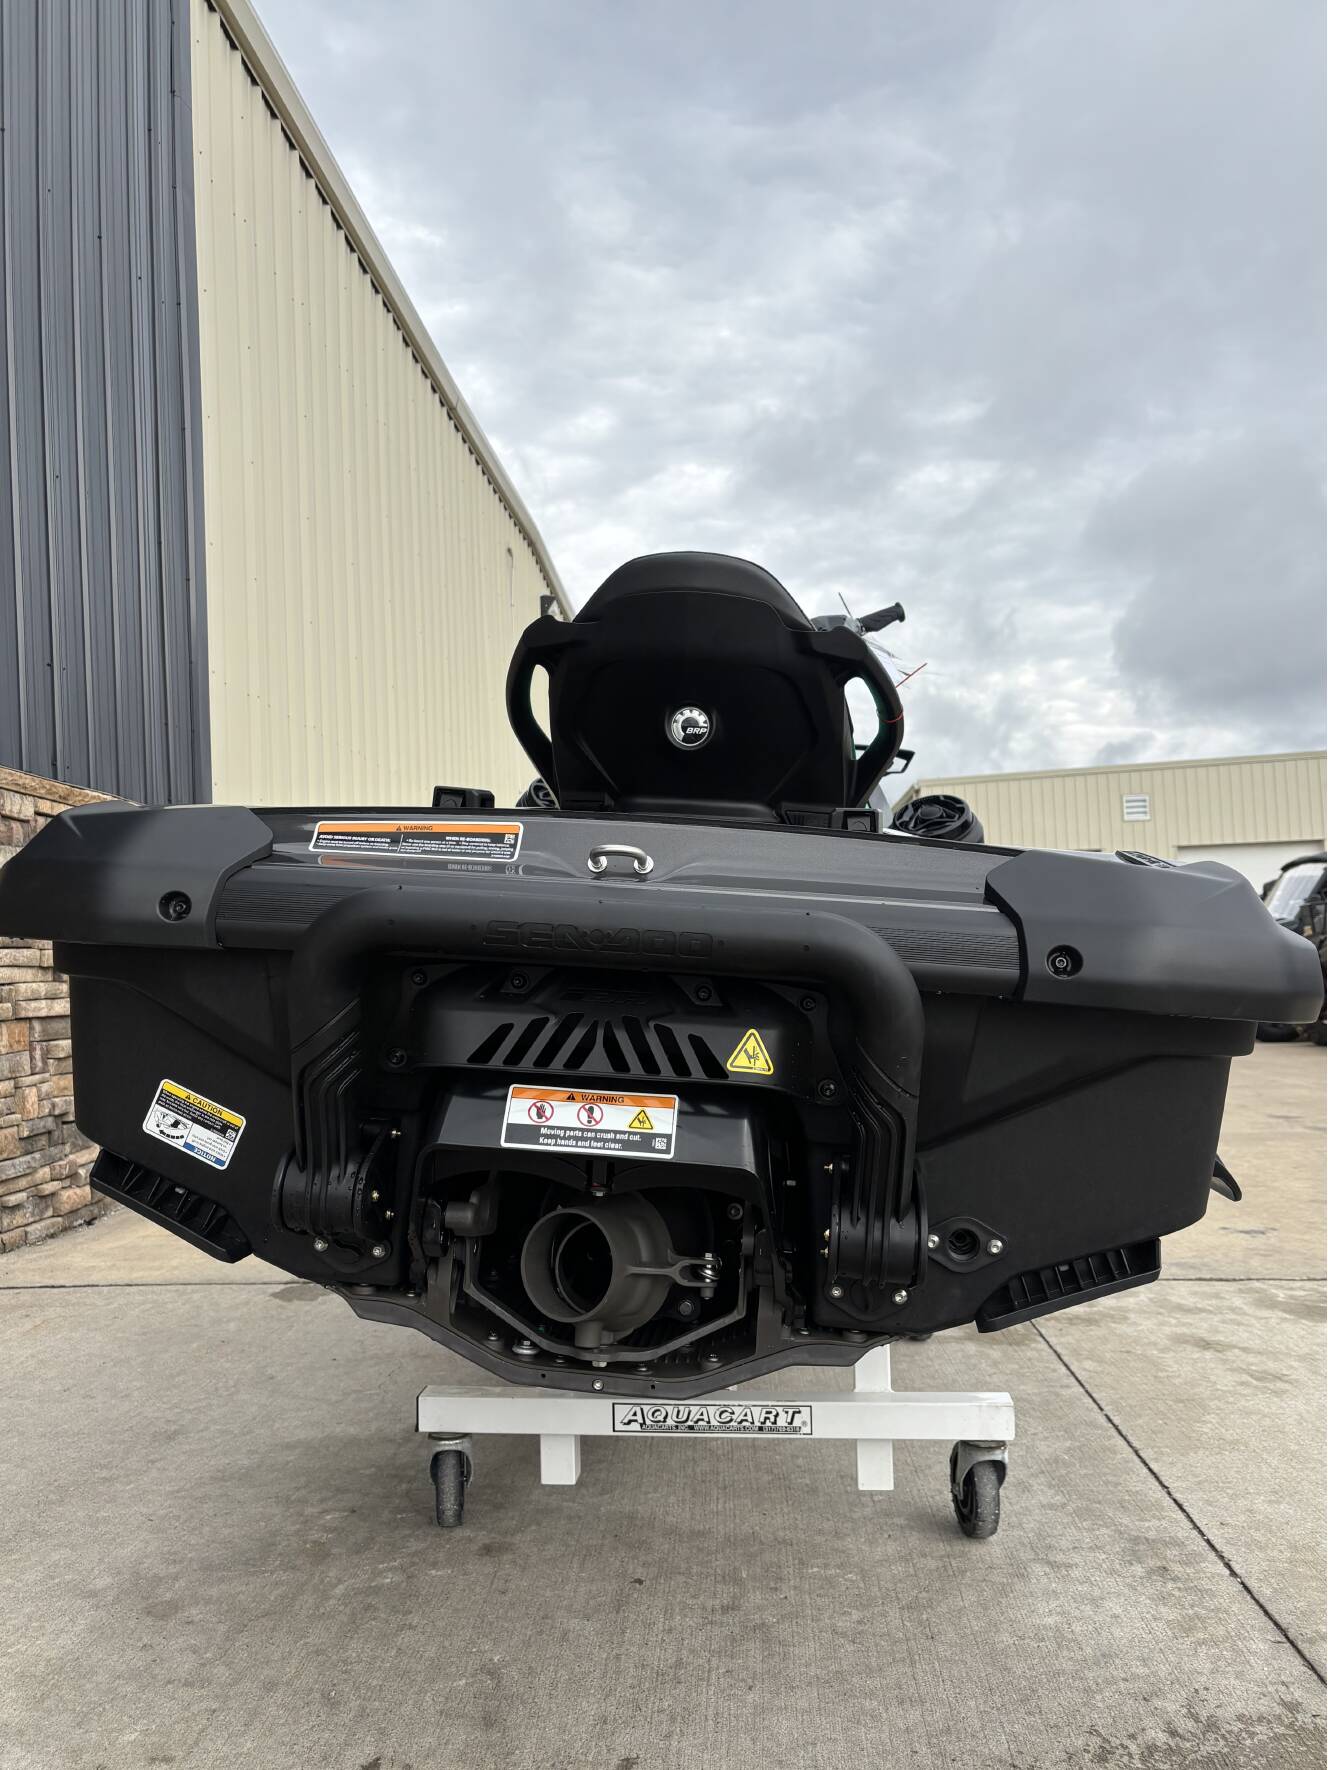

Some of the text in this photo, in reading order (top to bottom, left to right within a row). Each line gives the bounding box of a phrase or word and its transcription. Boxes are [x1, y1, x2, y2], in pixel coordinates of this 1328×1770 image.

[581, 1094, 624, 1104] WARNING
[192, 1097, 223, 1116] CAUTION
[540, 1127, 565, 1137] Moving
[565, 1130, 582, 1139] parts
[597, 1131, 615, 1139] crush
[616, 1132, 628, 1140] and
[539, 1137, 623, 1149] Keep hands and feet clear.
[195, 1148, 216, 1162] NOTICE
[620, 1405, 802, 1426] AQUACART
